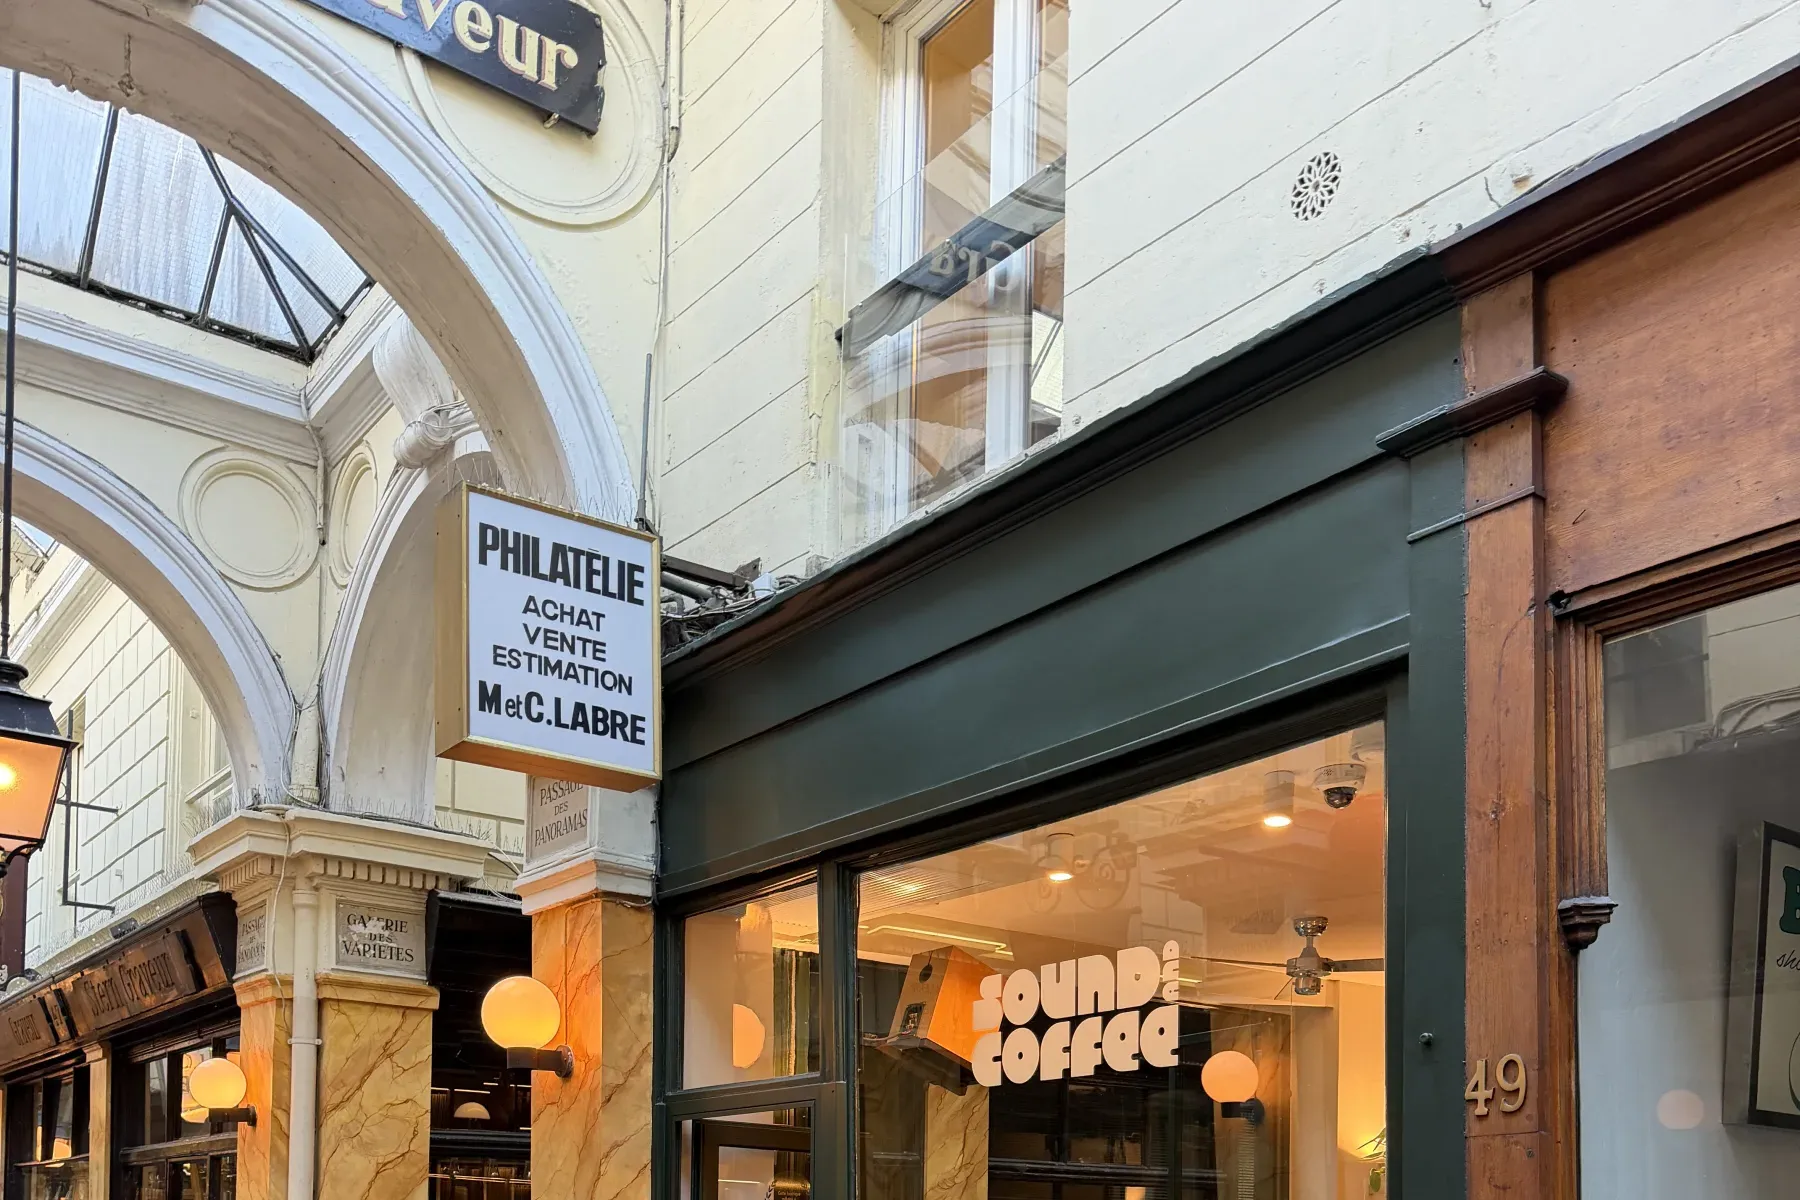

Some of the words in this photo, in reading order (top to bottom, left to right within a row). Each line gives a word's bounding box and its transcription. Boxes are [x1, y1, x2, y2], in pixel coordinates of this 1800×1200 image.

[521, 594, 606, 632] ACHAT
[521, 622, 607, 663] VENTE
[492, 643, 633, 697] ESTIMATION
[535, 808, 588, 848] PANORAMAS
[554, 801, 569, 816] DES
[83, 977, 126, 1017] Stern
[118, 952, 176, 1003] Graveur
[1464, 1053, 1527, 1116] 49
